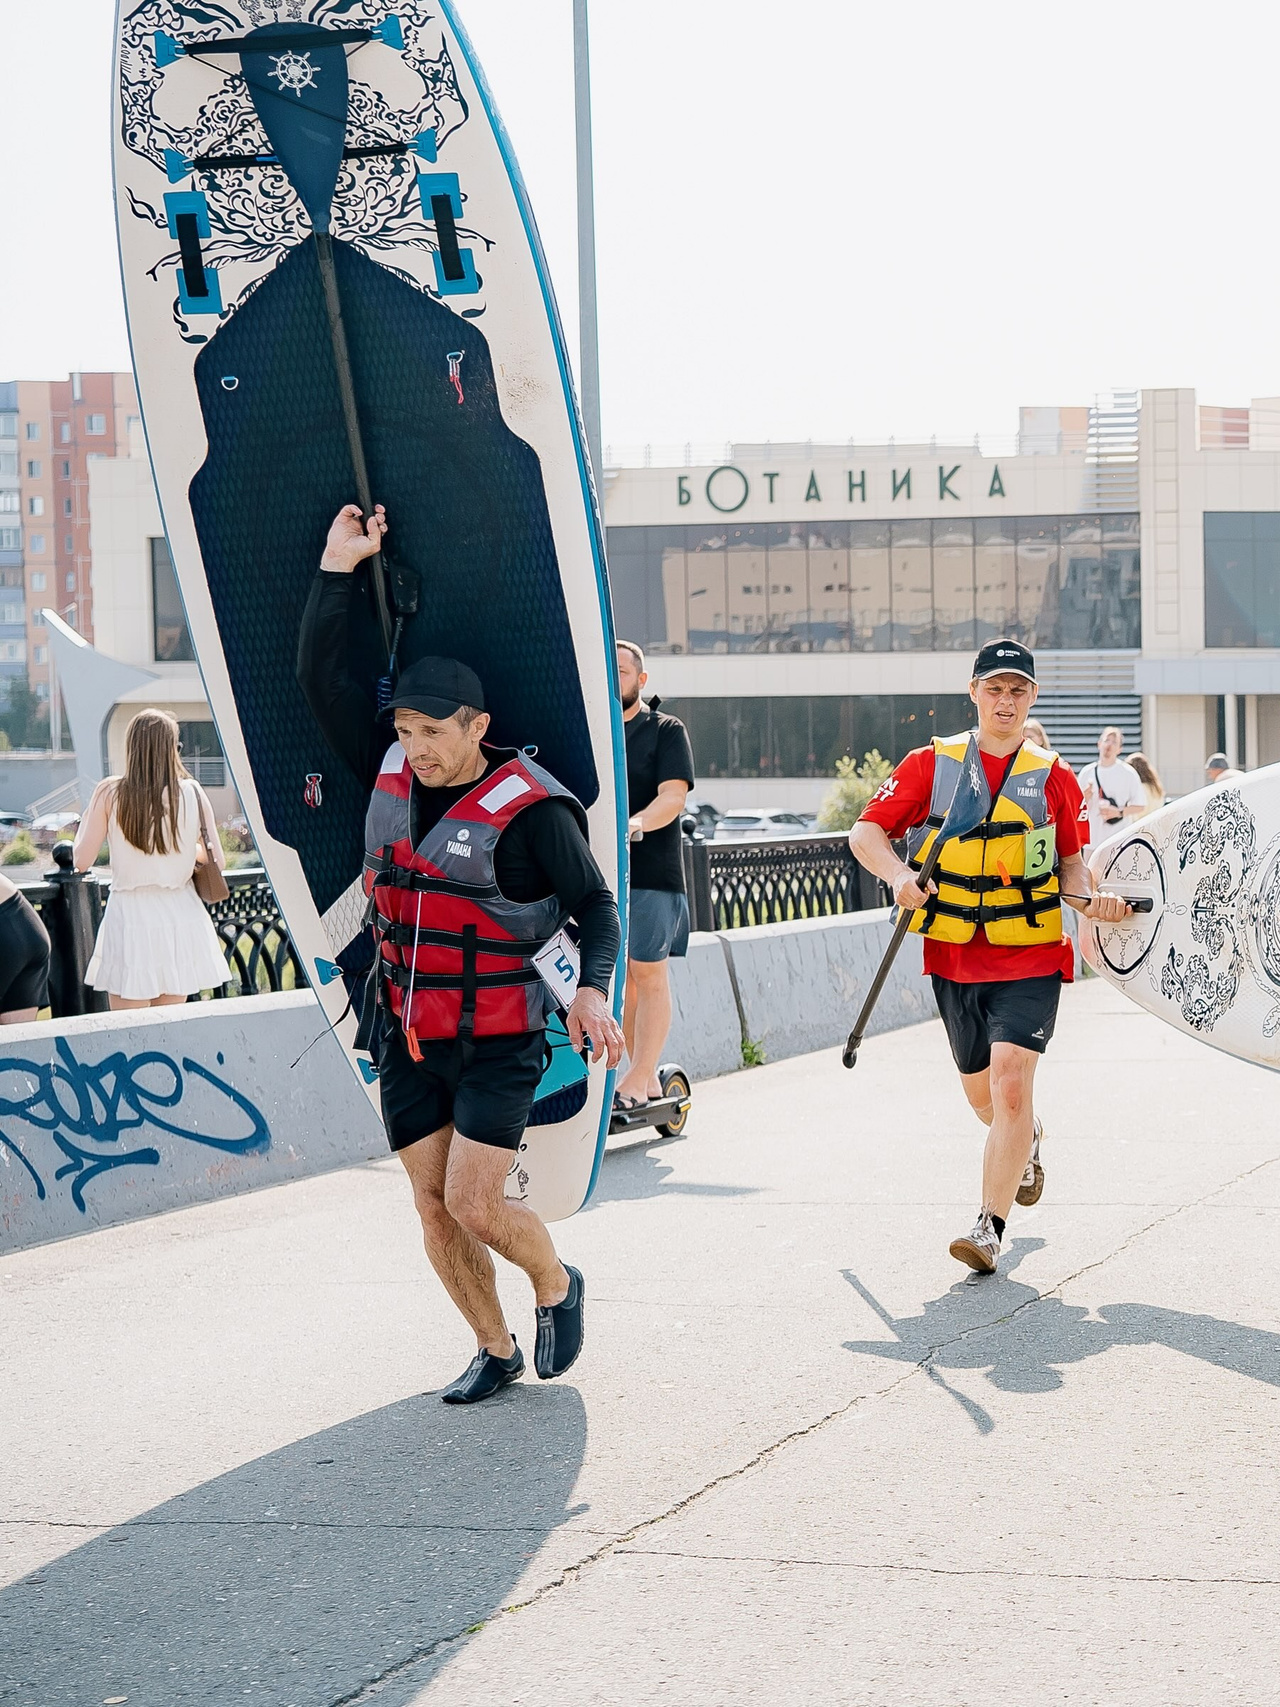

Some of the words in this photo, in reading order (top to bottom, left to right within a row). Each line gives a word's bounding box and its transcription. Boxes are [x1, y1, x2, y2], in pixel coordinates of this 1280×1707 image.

[677, 464, 1006, 512] БОТАНИКА
[1017, 786, 1042, 797] YAMAHA
[446, 841, 472, 859] YAMAHA
[1031, 838, 1047, 869] 3
[553, 954, 575, 984] 5
